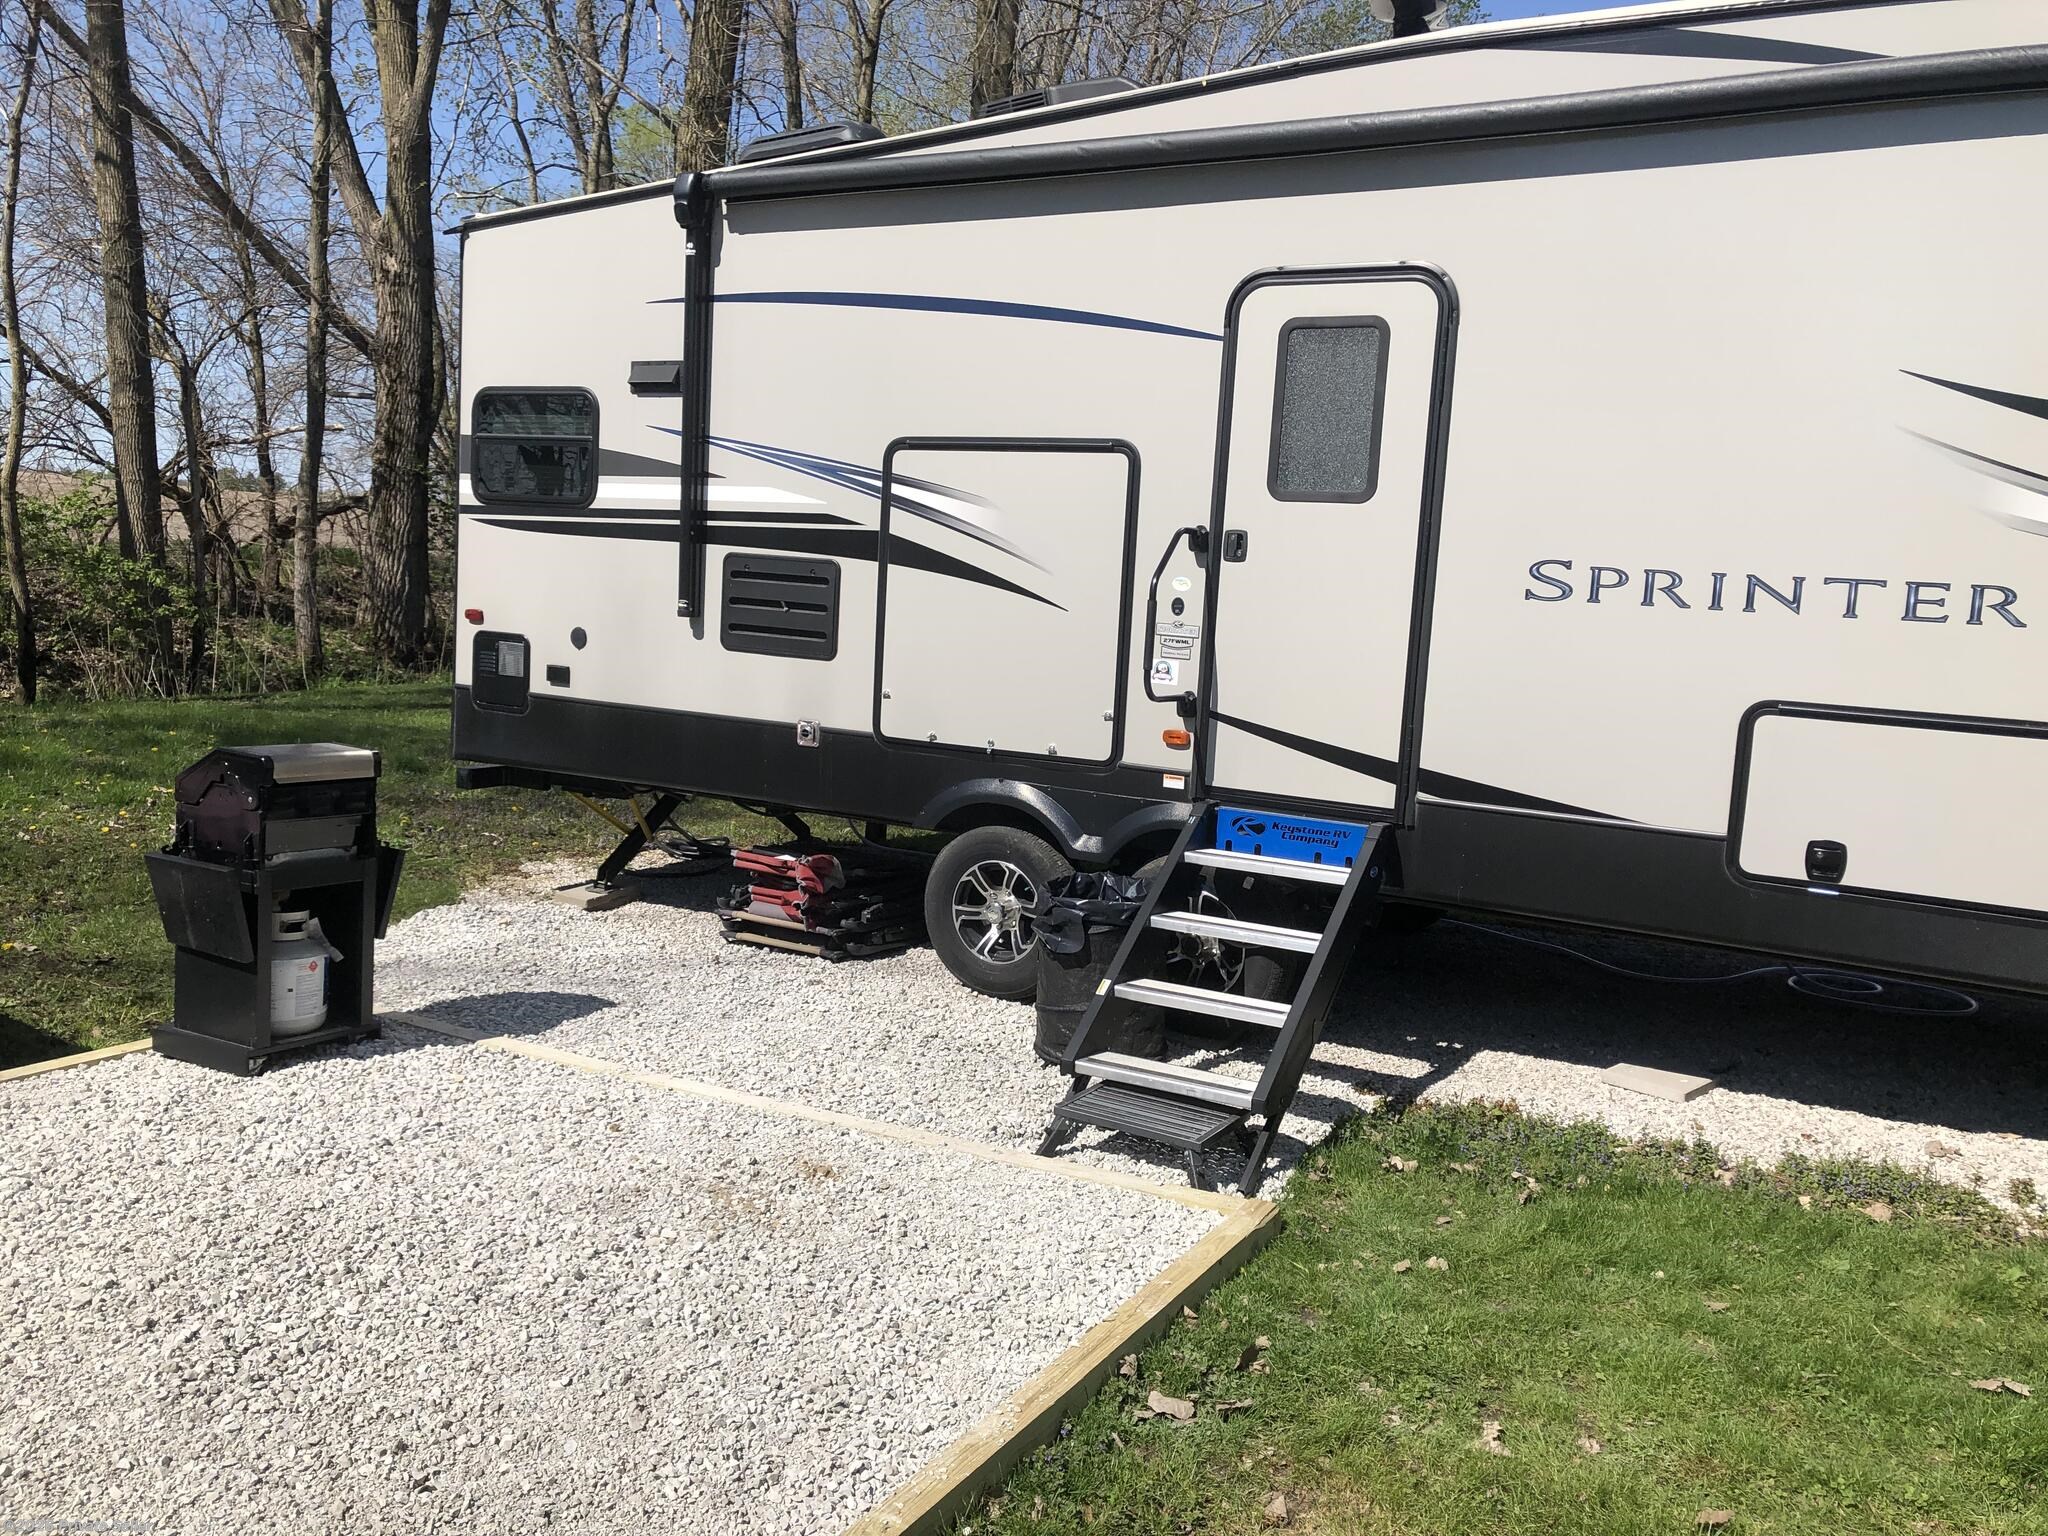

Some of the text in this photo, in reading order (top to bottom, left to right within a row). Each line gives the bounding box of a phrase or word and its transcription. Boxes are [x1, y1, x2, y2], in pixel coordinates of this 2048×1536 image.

[1524, 559, 2028, 628] SPRINTER
[1272, 822, 1351, 839] Keystone RV
[1281, 831, 1340, 848] Company
